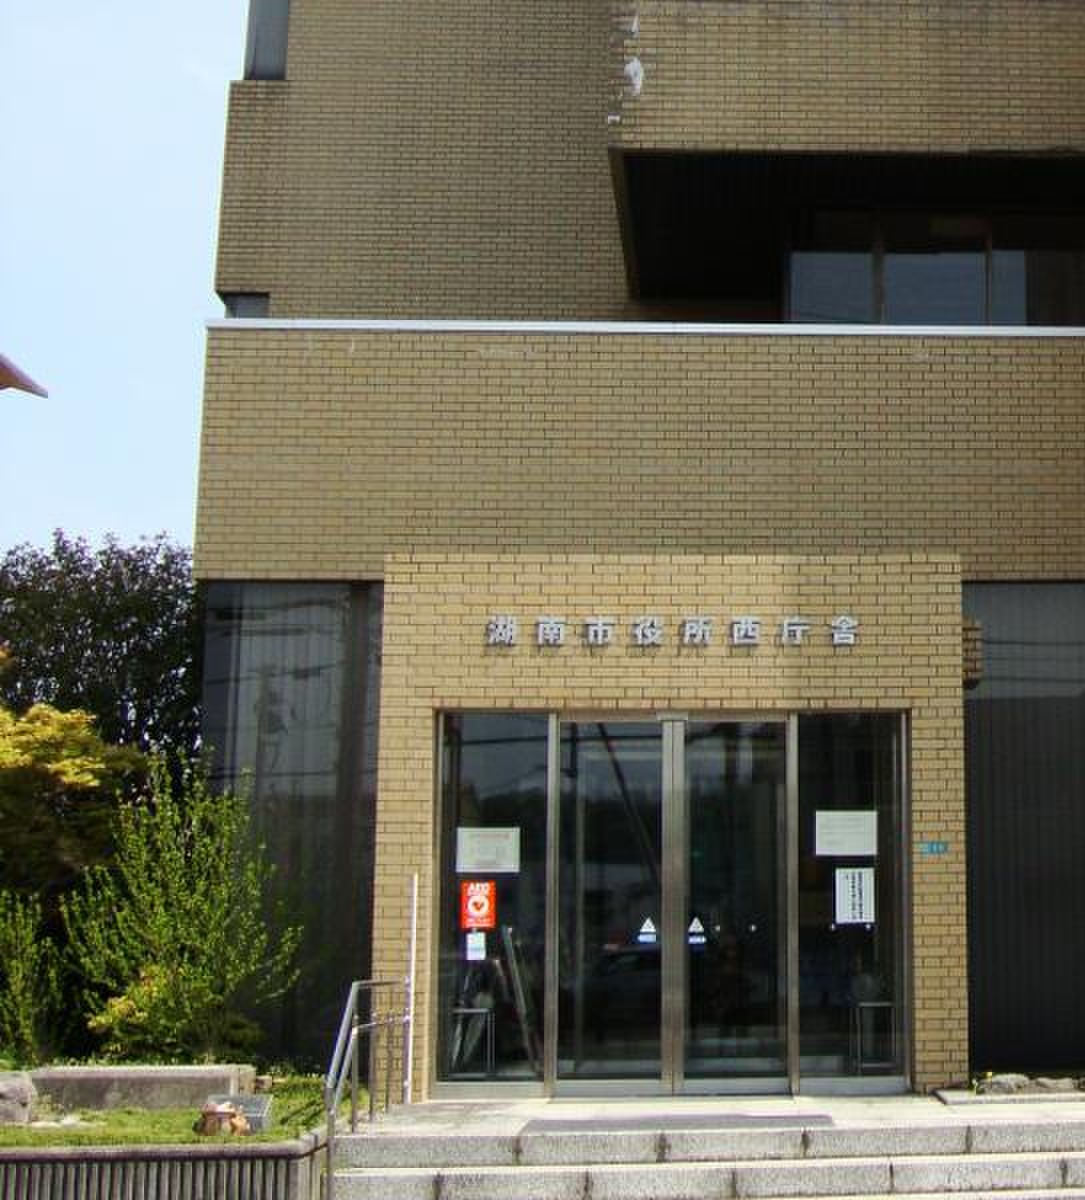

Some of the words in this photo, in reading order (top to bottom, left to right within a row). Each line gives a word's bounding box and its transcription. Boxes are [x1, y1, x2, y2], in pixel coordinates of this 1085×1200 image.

[487, 615, 859, 646] 湖南市役所西庁舎
